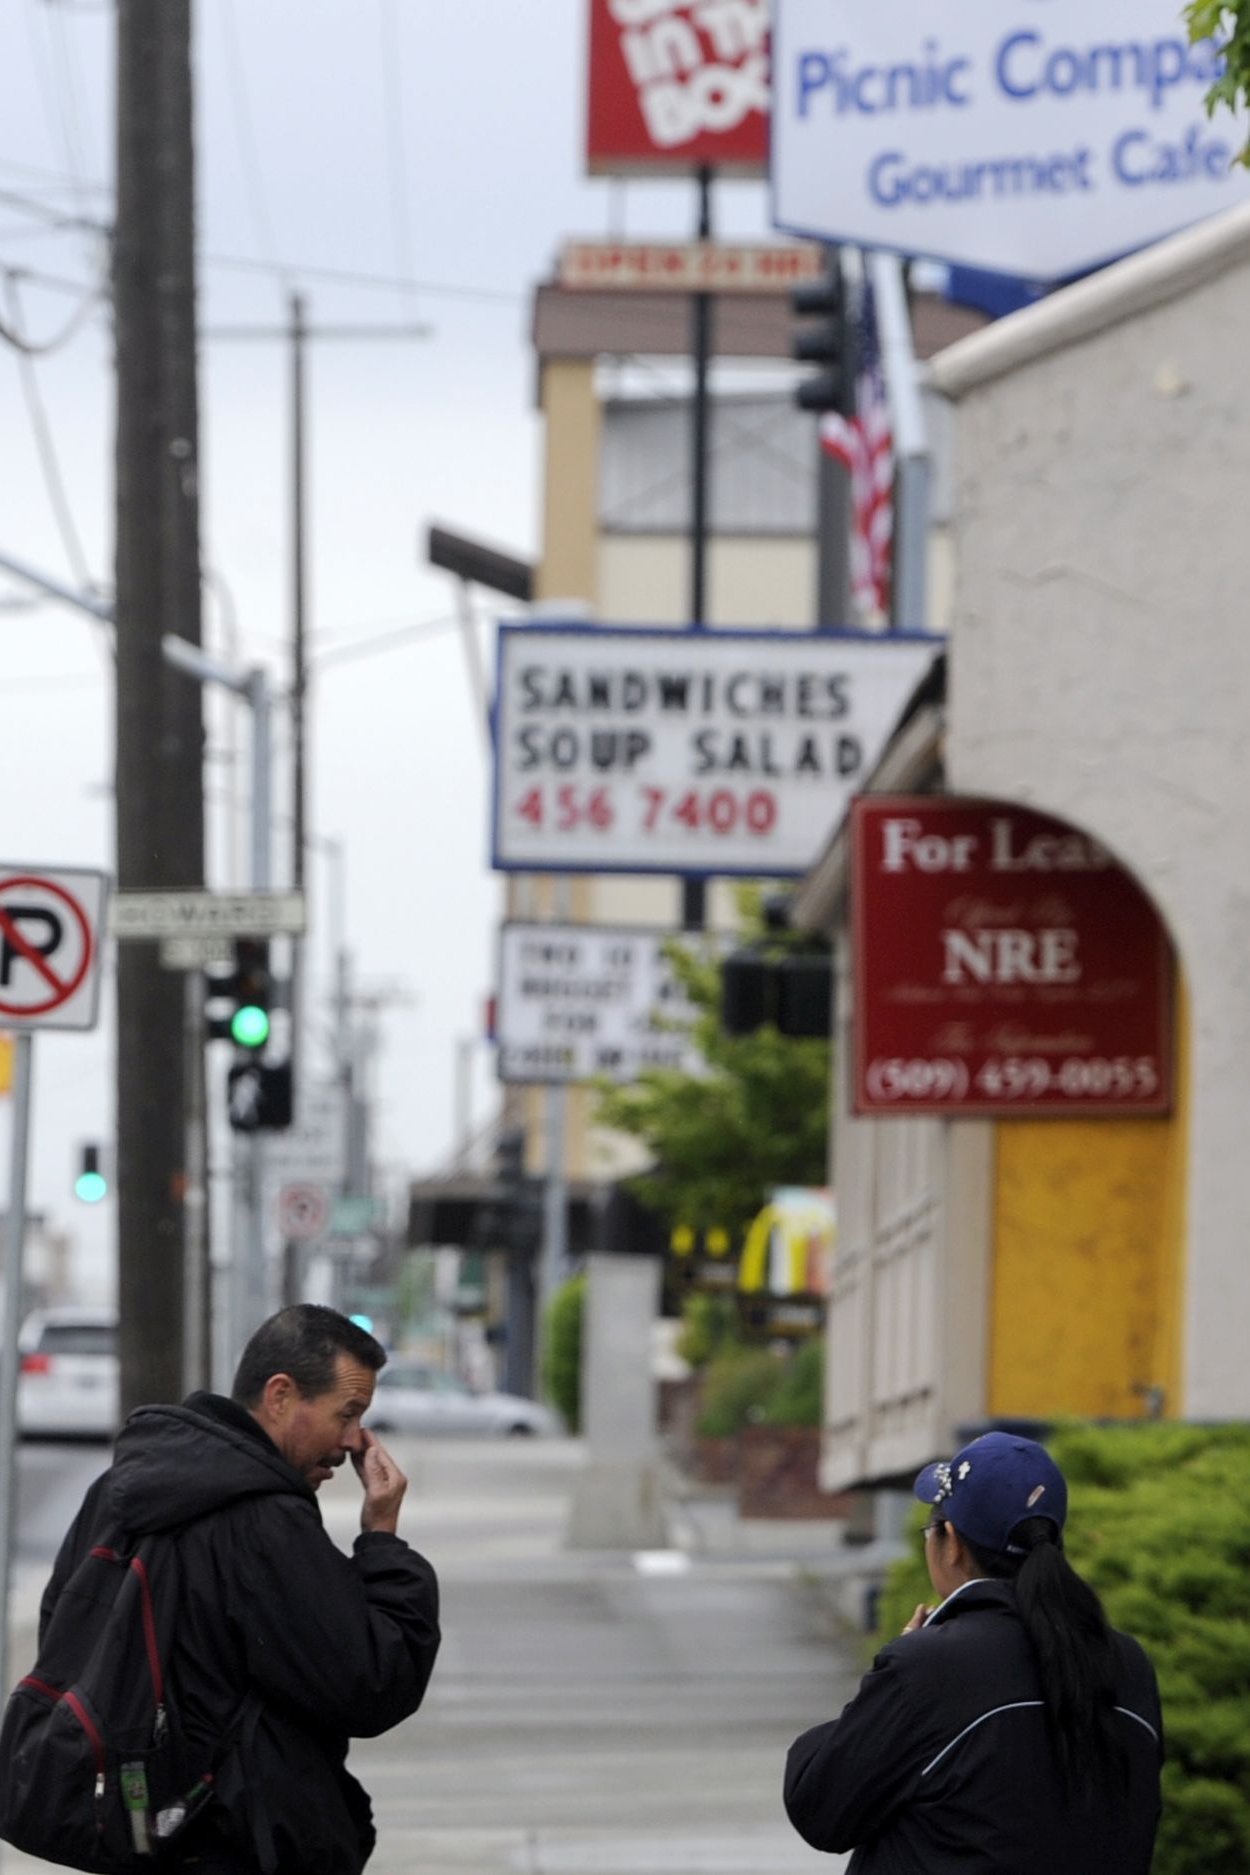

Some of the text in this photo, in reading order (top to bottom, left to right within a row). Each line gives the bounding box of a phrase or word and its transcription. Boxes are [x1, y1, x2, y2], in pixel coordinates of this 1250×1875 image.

[796, 38, 971, 120] Picnic
[867, 147, 1091, 207] Gourmet
[518, 666, 850, 718] SANDWICHES
[517, 724, 863, 778] SOUP SALAD
[517, 783, 777, 836] 456 7400
[881, 817, 977, 873] For
[0, 907, 62, 986] P
[941, 927, 1082, 985] NRE
[866, 1055, 970, 1102] (509)
